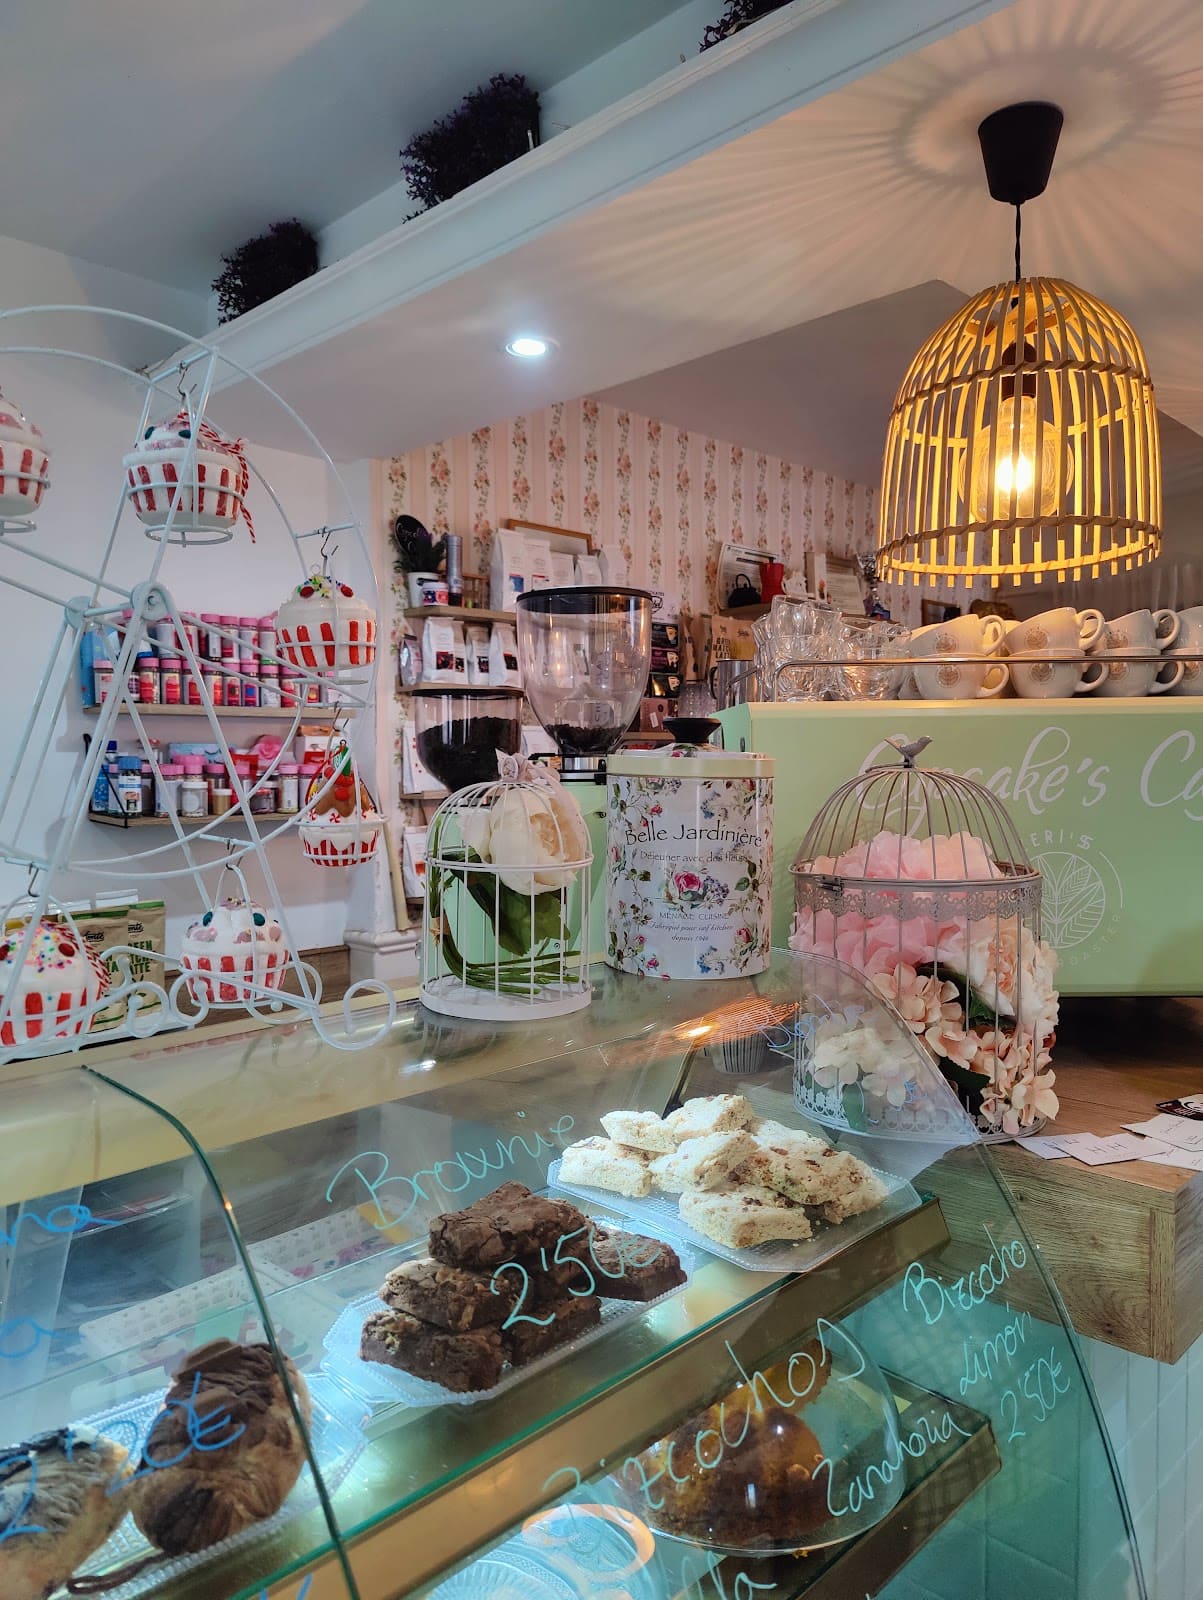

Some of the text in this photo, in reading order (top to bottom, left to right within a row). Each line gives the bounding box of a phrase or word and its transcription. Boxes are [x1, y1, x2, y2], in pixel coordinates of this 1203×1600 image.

[625, 820, 762, 848] Belle Jardinière
[1029, 829, 1094, 850] ERI'S
[325, 1110, 578, 1231] Brownie
[903, 1223, 1027, 1325] Bizcocho
[811, 1408, 973, 1518] Zanahoria
